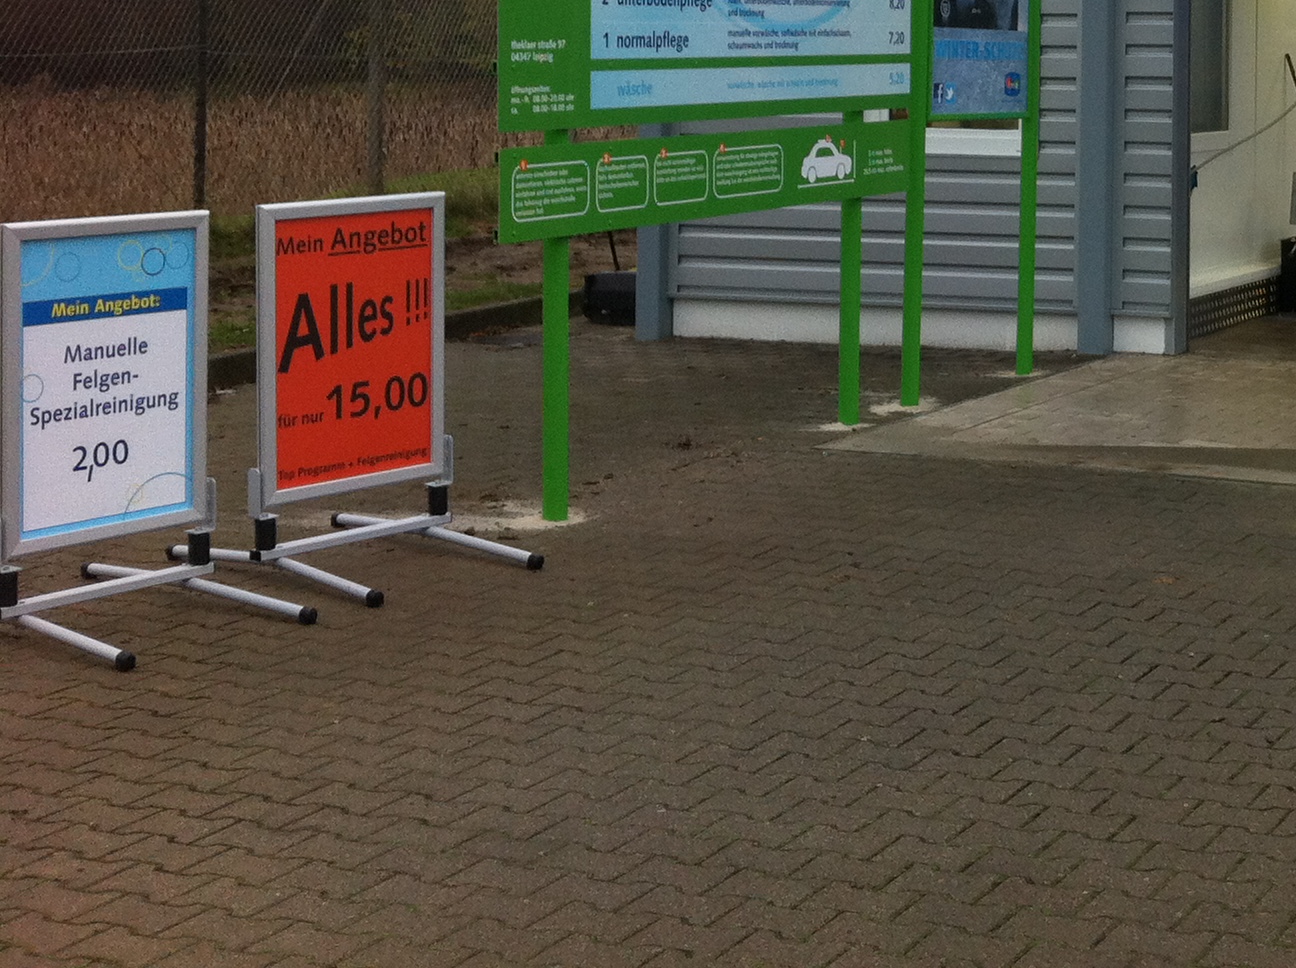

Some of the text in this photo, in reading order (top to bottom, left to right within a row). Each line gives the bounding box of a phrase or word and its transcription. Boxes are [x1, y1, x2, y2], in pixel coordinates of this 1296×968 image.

[603, 31, 689, 52] 1 normalpflege
[889, 32, 905, 46] 7,20
[277, 222, 427, 257] Mein Angebot
[52, 296, 161, 318] Mein Angebot:
[278, 282, 394, 373] Alles
[64, 337, 148, 364] Manuelle
[73, 372, 139, 393] Felgen-
[30, 392, 179, 429] Spezialreinigung
[278, 372, 428, 427] für nur 15,00
[73, 439, 129, 482] 2,00
[298, 462, 345, 478] Programm
[357, 448, 428, 466] Felgenreinigung
